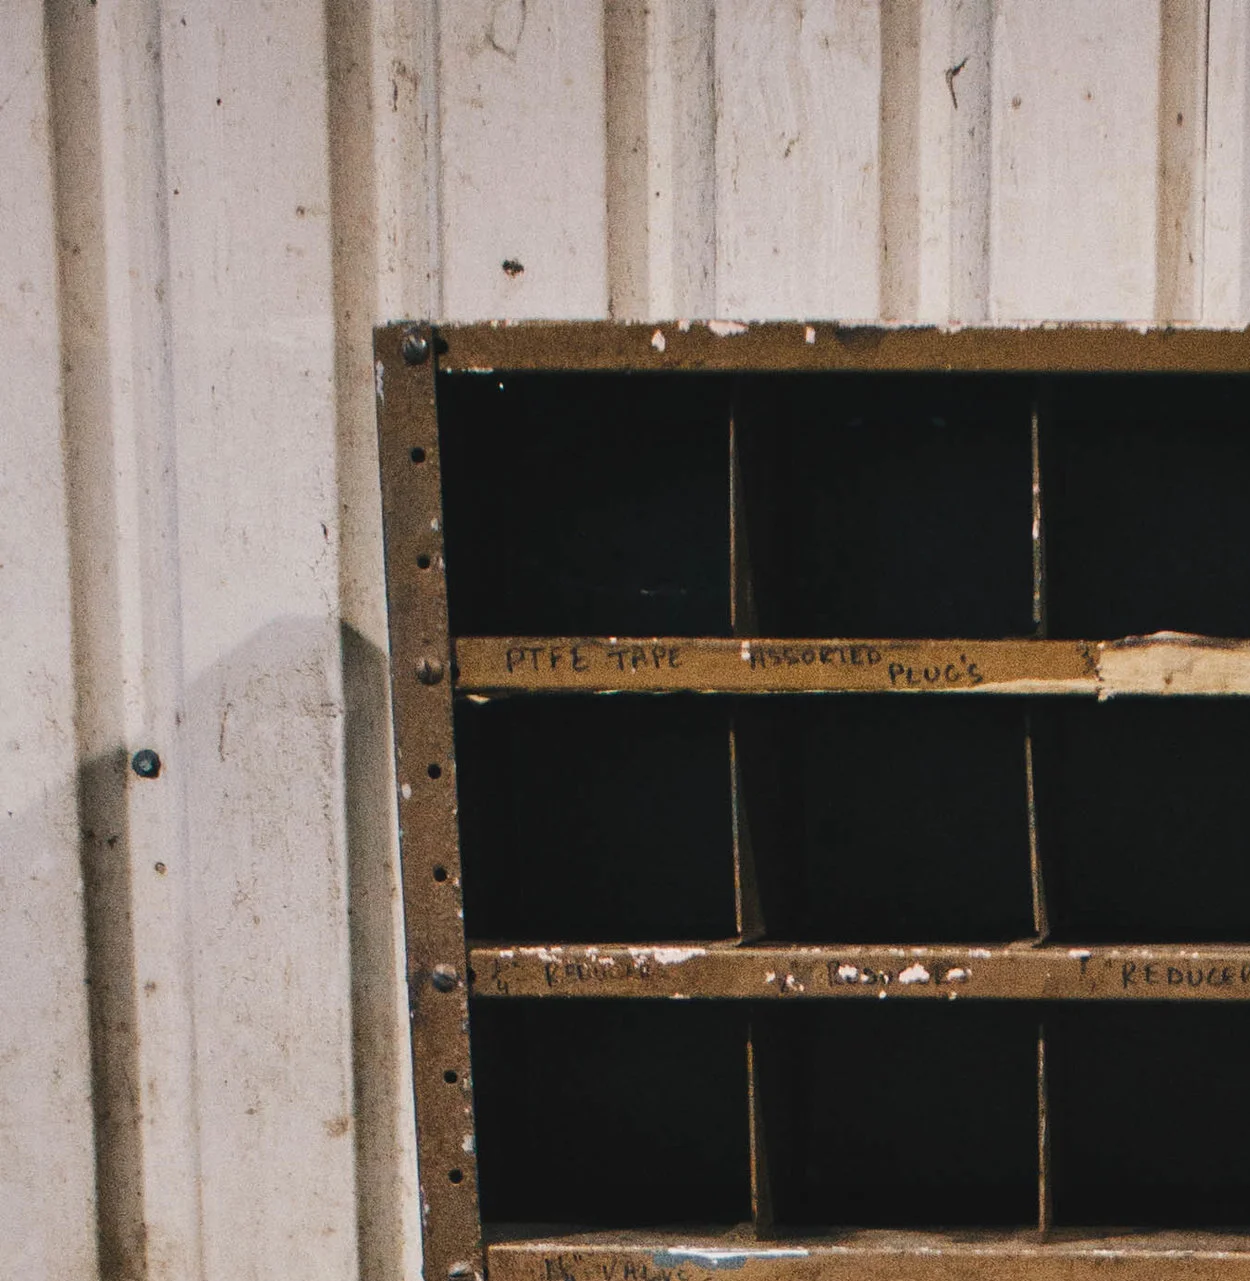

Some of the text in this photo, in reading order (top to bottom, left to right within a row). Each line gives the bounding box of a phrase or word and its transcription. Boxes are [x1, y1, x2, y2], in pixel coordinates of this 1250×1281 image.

[506, 645, 682, 673] PTFE TAPE
[750, 645, 883, 670] ASSORTED
